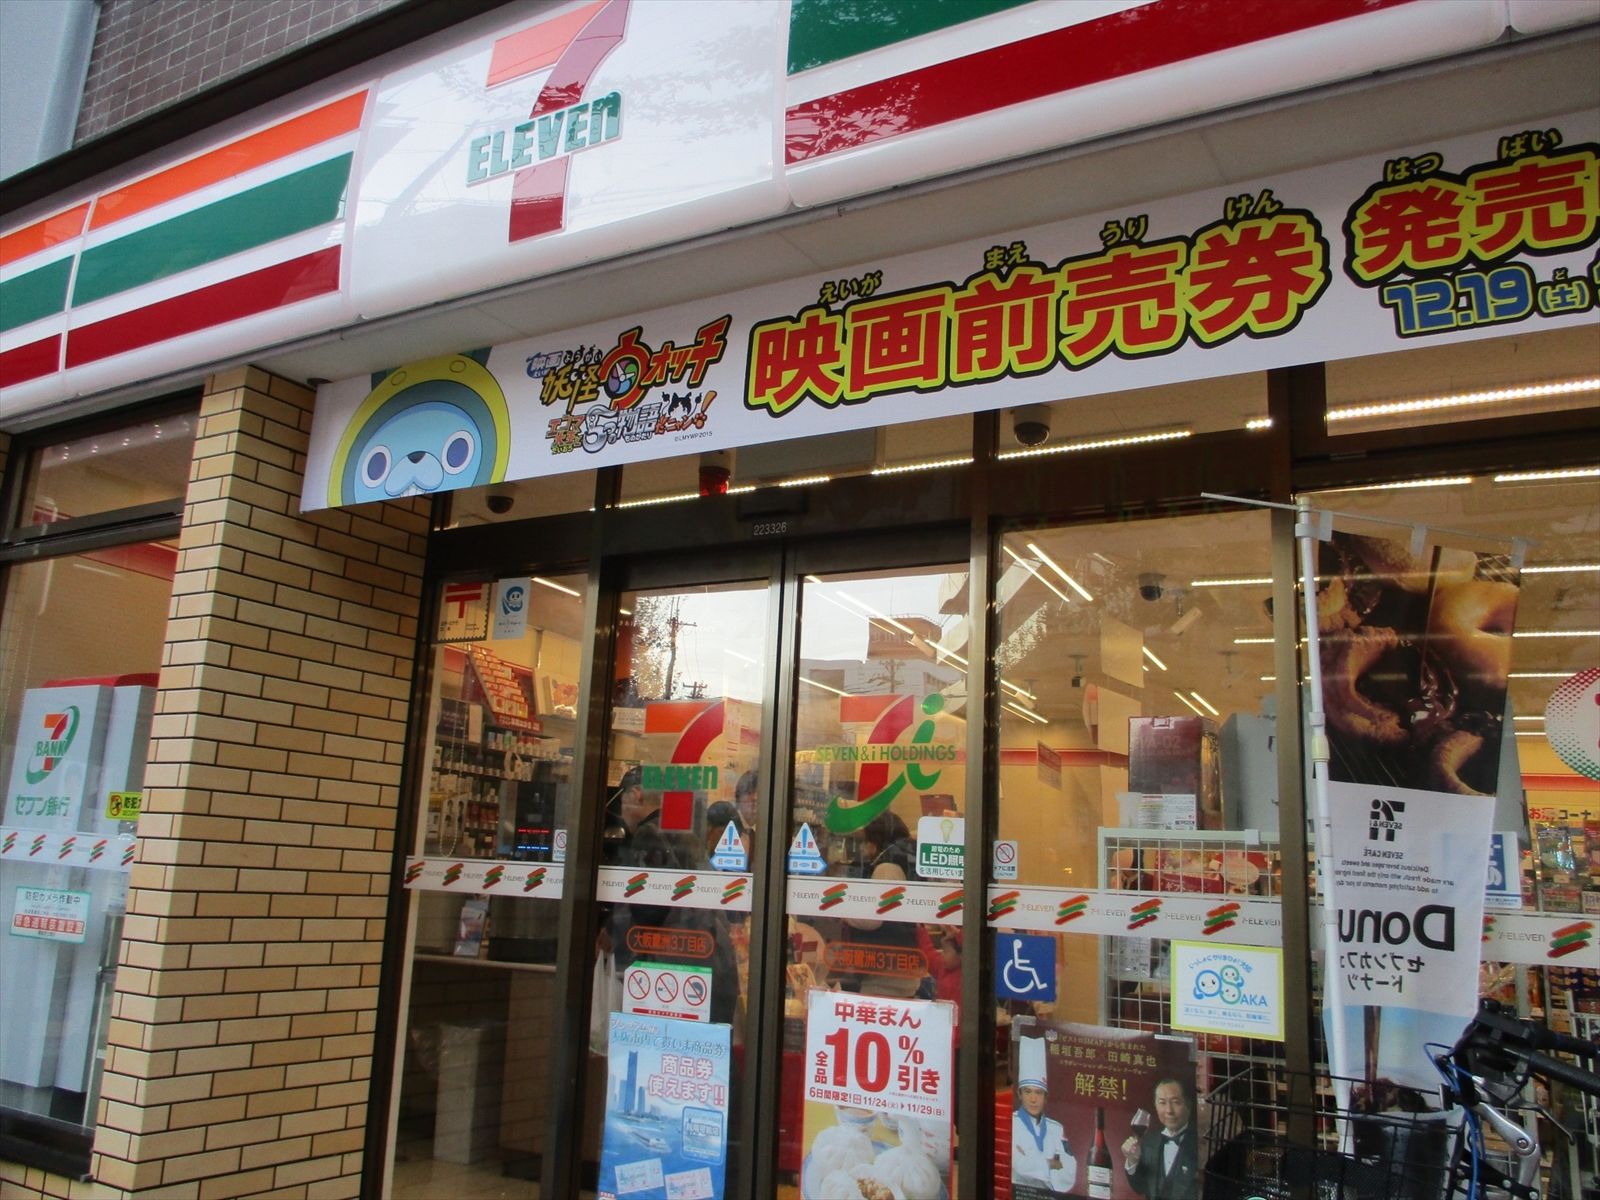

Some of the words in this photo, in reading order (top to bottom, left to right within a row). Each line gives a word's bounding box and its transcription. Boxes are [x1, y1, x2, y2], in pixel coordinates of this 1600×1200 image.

[1223, 189, 1281, 220] けん
[1100, 215, 1149, 246] うり
[984, 242, 1028, 269] まえ
[820, 271, 882, 303] えいが
[748, 216, 1320, 412] 映画前売券
[753, 521, 787, 536] 223326
[36, 741, 66, 757] BANK
[880, 744, 956, 761] HOLDINGS
[835, 1000, 922, 1030] 中華まん
[662, 1054, 714, 1080] 商品券
[814, 1050, 829, 1085] 全品
[1074, 1072, 1127, 1101] 解禁!
